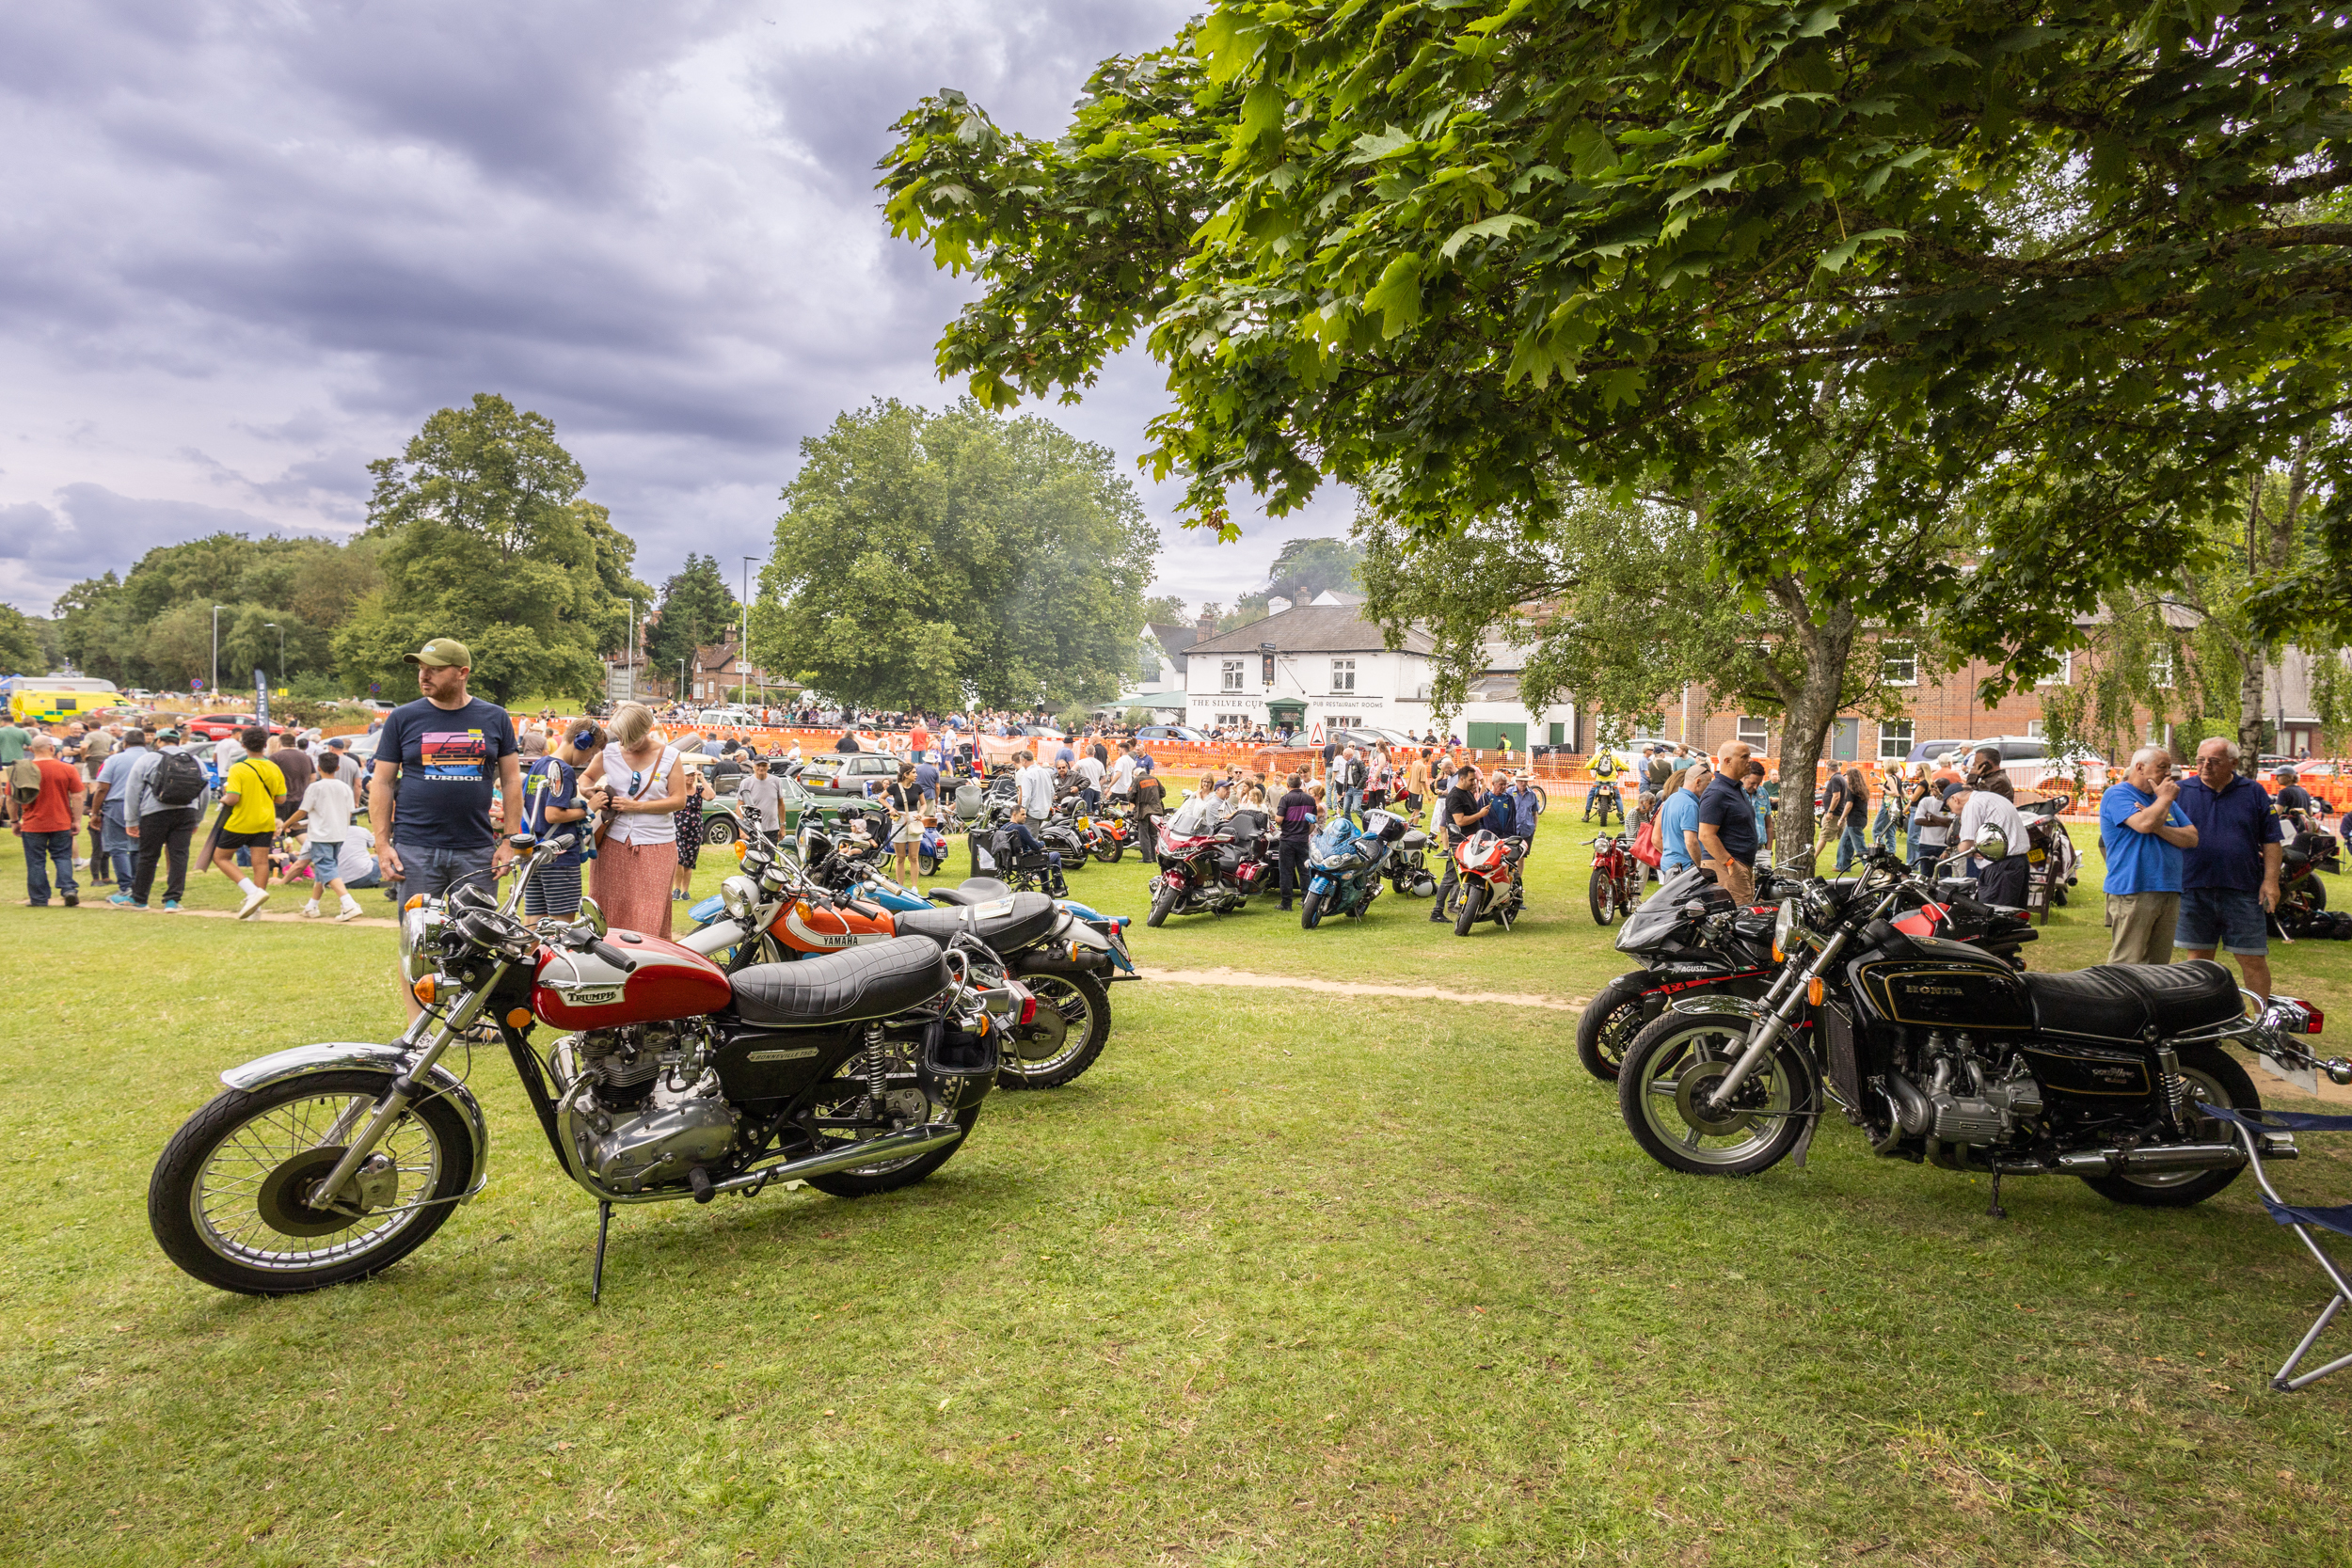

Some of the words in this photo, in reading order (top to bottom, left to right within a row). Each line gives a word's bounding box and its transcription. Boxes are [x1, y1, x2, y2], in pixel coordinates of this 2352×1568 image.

[823, 936, 858, 945] YAMAHA
[1666, 981, 1689, 992] F4
[1905, 984, 1964, 995] HONDA
[567, 991, 616, 1004] TRIUMPH
[755, 1052, 799, 1060] BONNEVILLE
